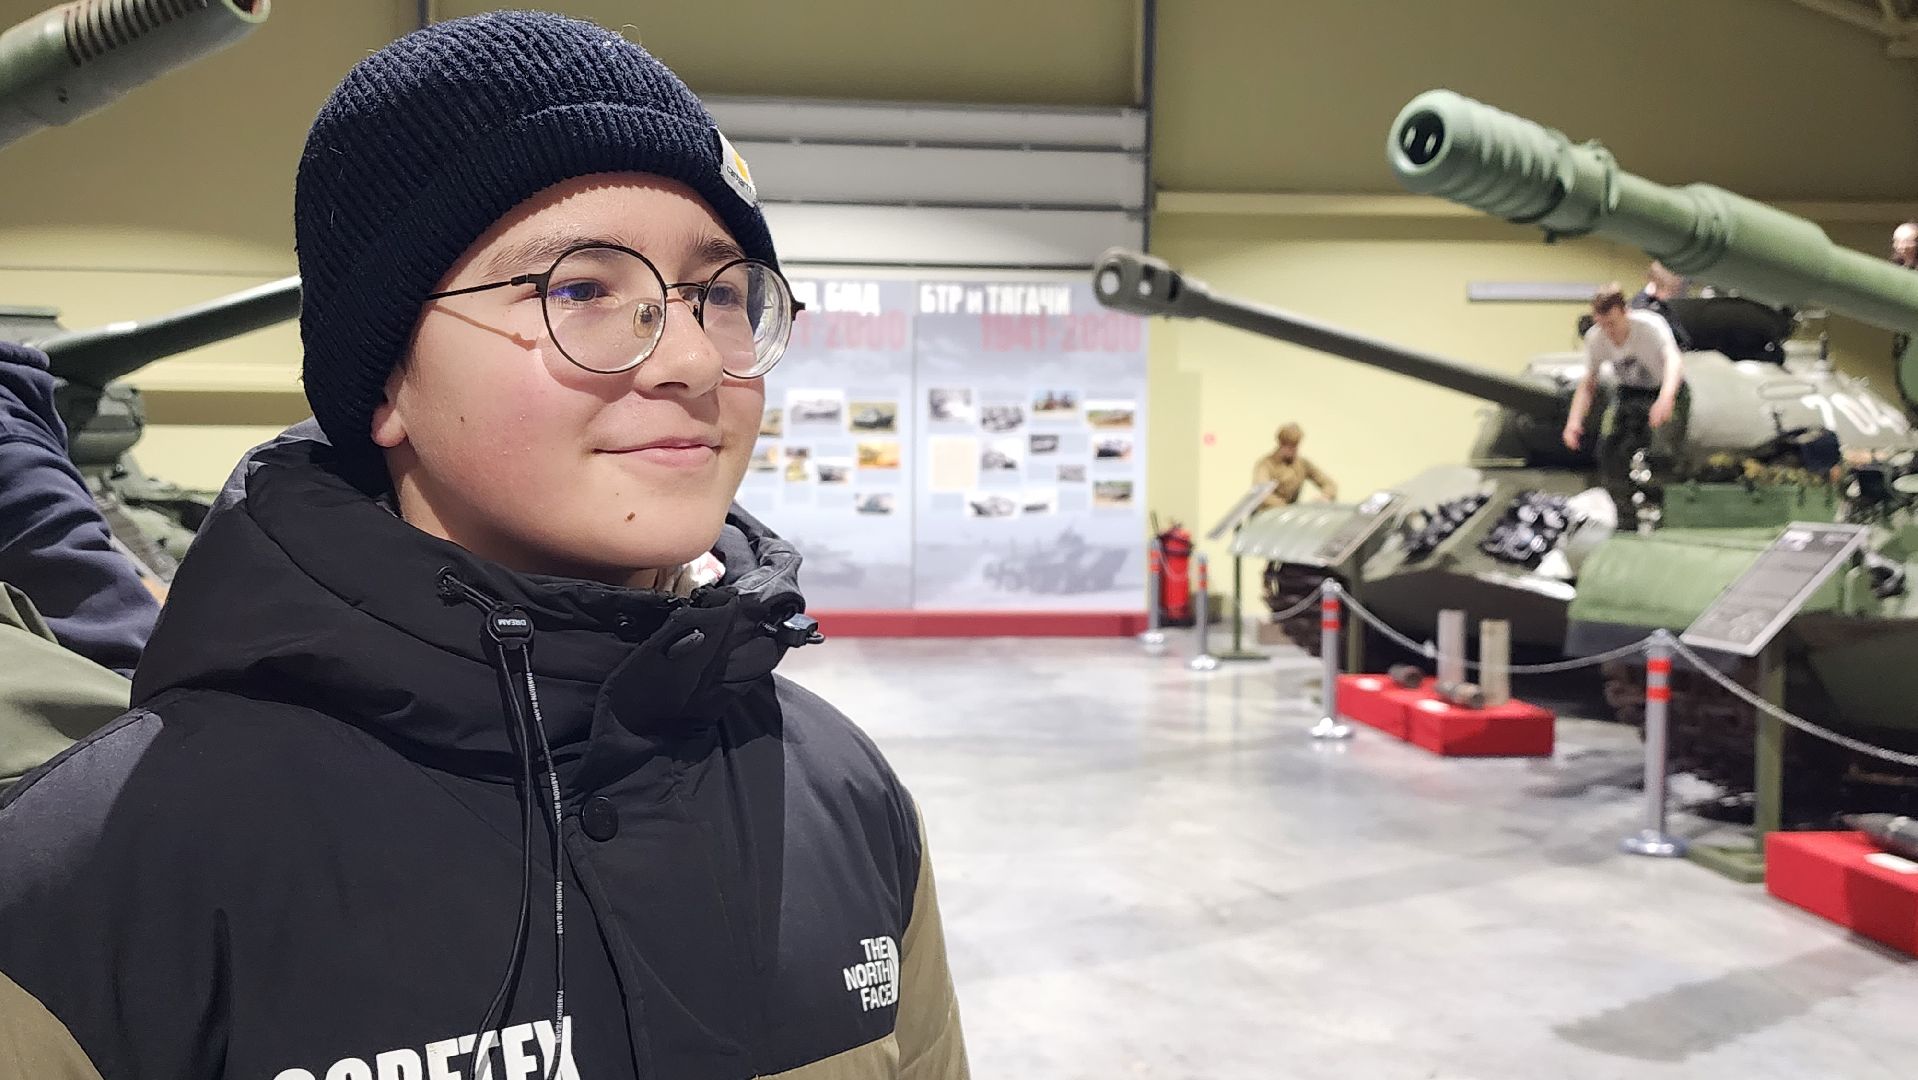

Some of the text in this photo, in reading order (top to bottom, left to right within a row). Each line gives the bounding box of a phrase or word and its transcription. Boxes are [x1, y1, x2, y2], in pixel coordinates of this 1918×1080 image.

[920, 284, 963, 314] БТР
[986, 285, 1071, 315] ТЯГАЧИ
[497, 618, 528, 627] DREAM
[860, 935, 890, 962] THE
[842, 959, 892, 991] NORTH
[860, 983, 893, 1012] FACE
